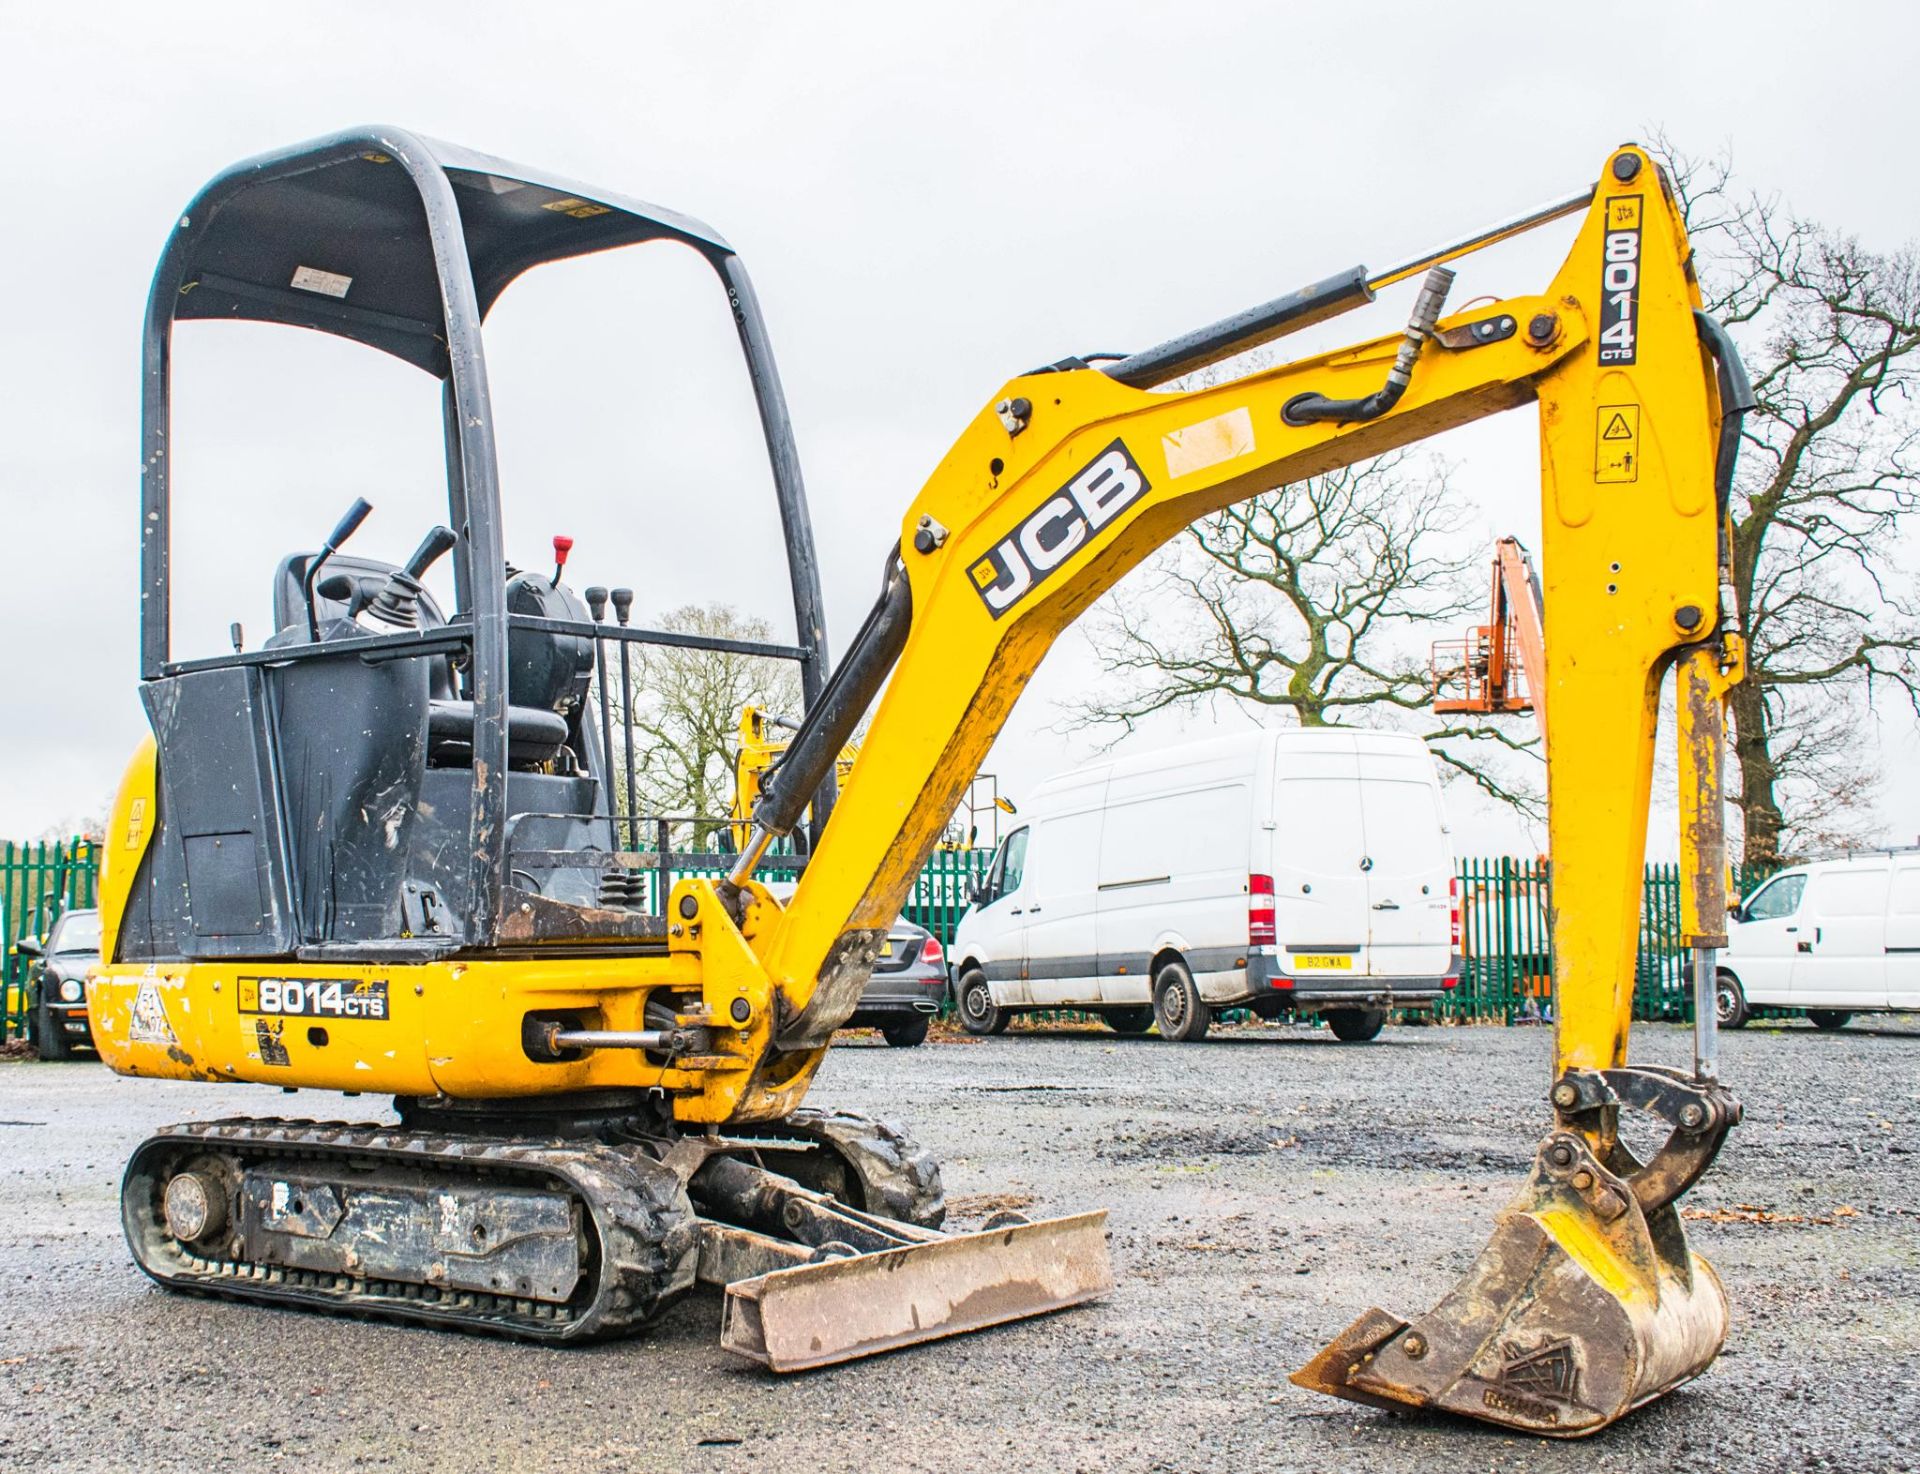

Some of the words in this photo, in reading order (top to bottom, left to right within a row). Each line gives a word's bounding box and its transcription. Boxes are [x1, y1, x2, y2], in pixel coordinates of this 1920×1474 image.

[1600, 232, 1639, 349] 8014
[1600, 349, 1633, 360] CTS
[984, 450, 1142, 609] JCB
